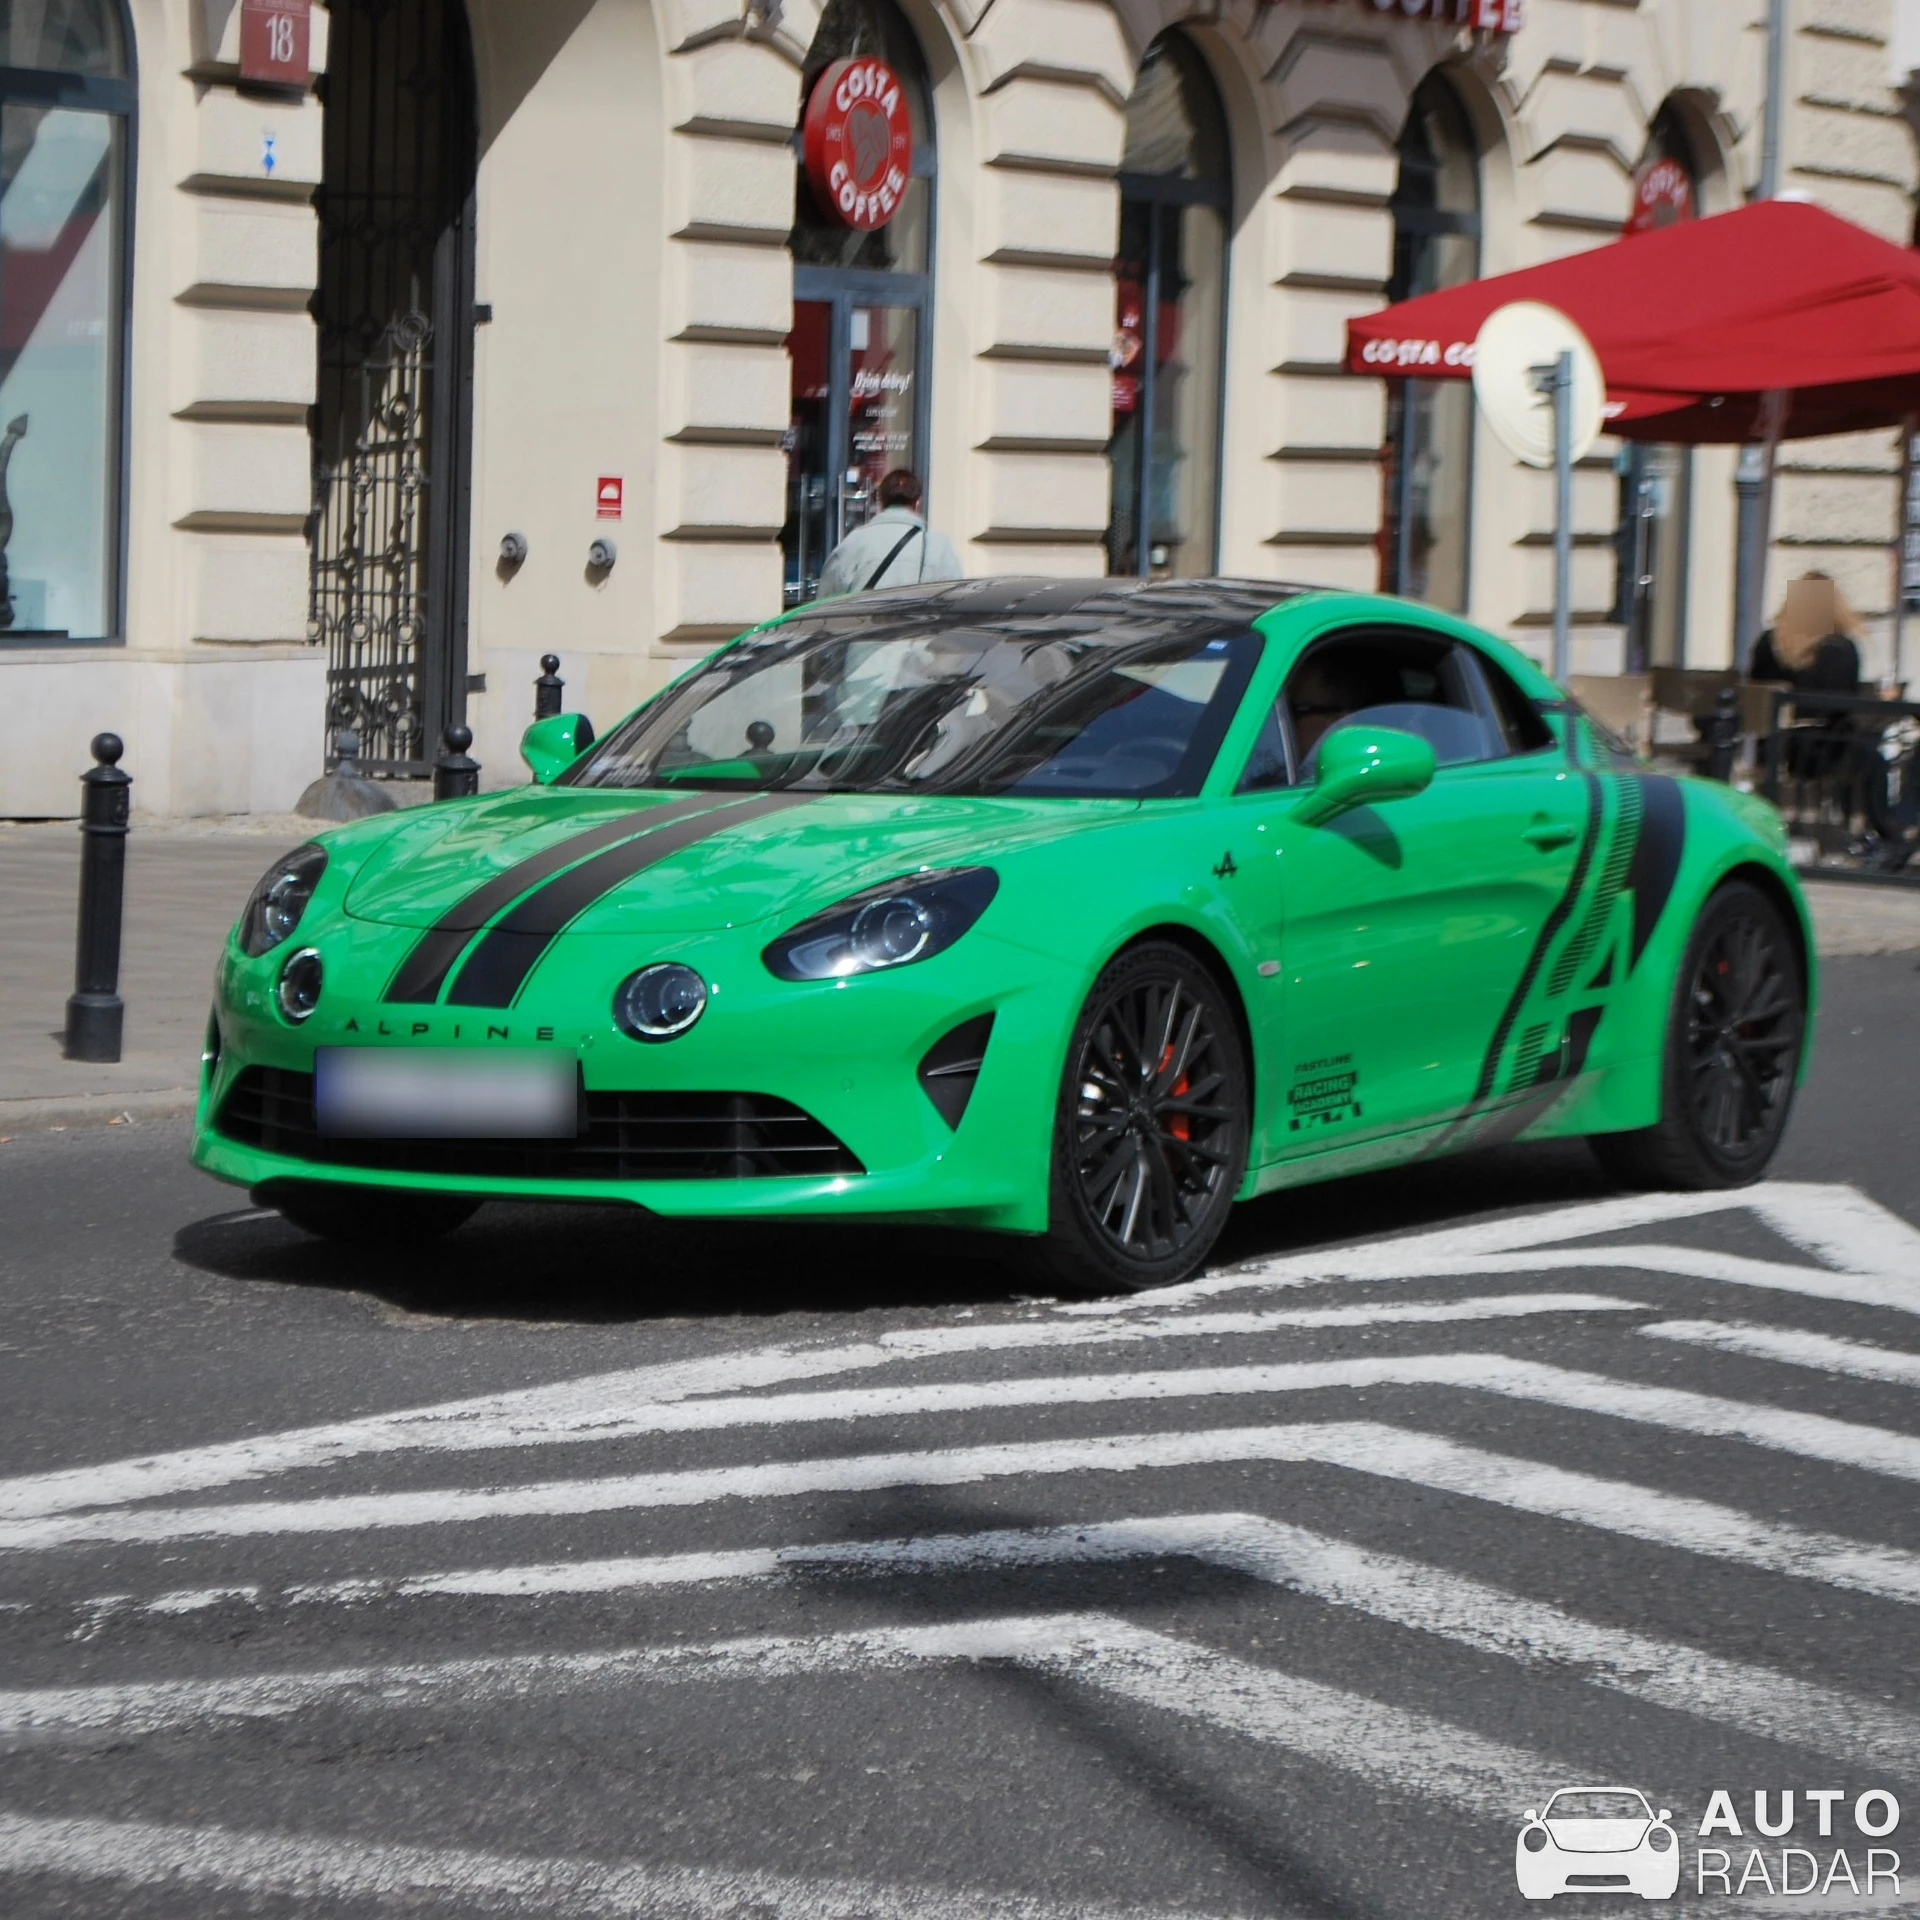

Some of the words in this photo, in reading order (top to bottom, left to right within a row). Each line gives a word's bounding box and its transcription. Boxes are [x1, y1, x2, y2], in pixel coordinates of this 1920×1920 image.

[265, 12, 294, 63] 18
[836, 63, 899, 120] COSTA
[830, 160, 905, 225] COFFEE
[1362, 338, 1441, 367] COSTA
[344, 1017, 555, 1042] ALPINE
[1294, 1075, 1350, 1101] RACING
